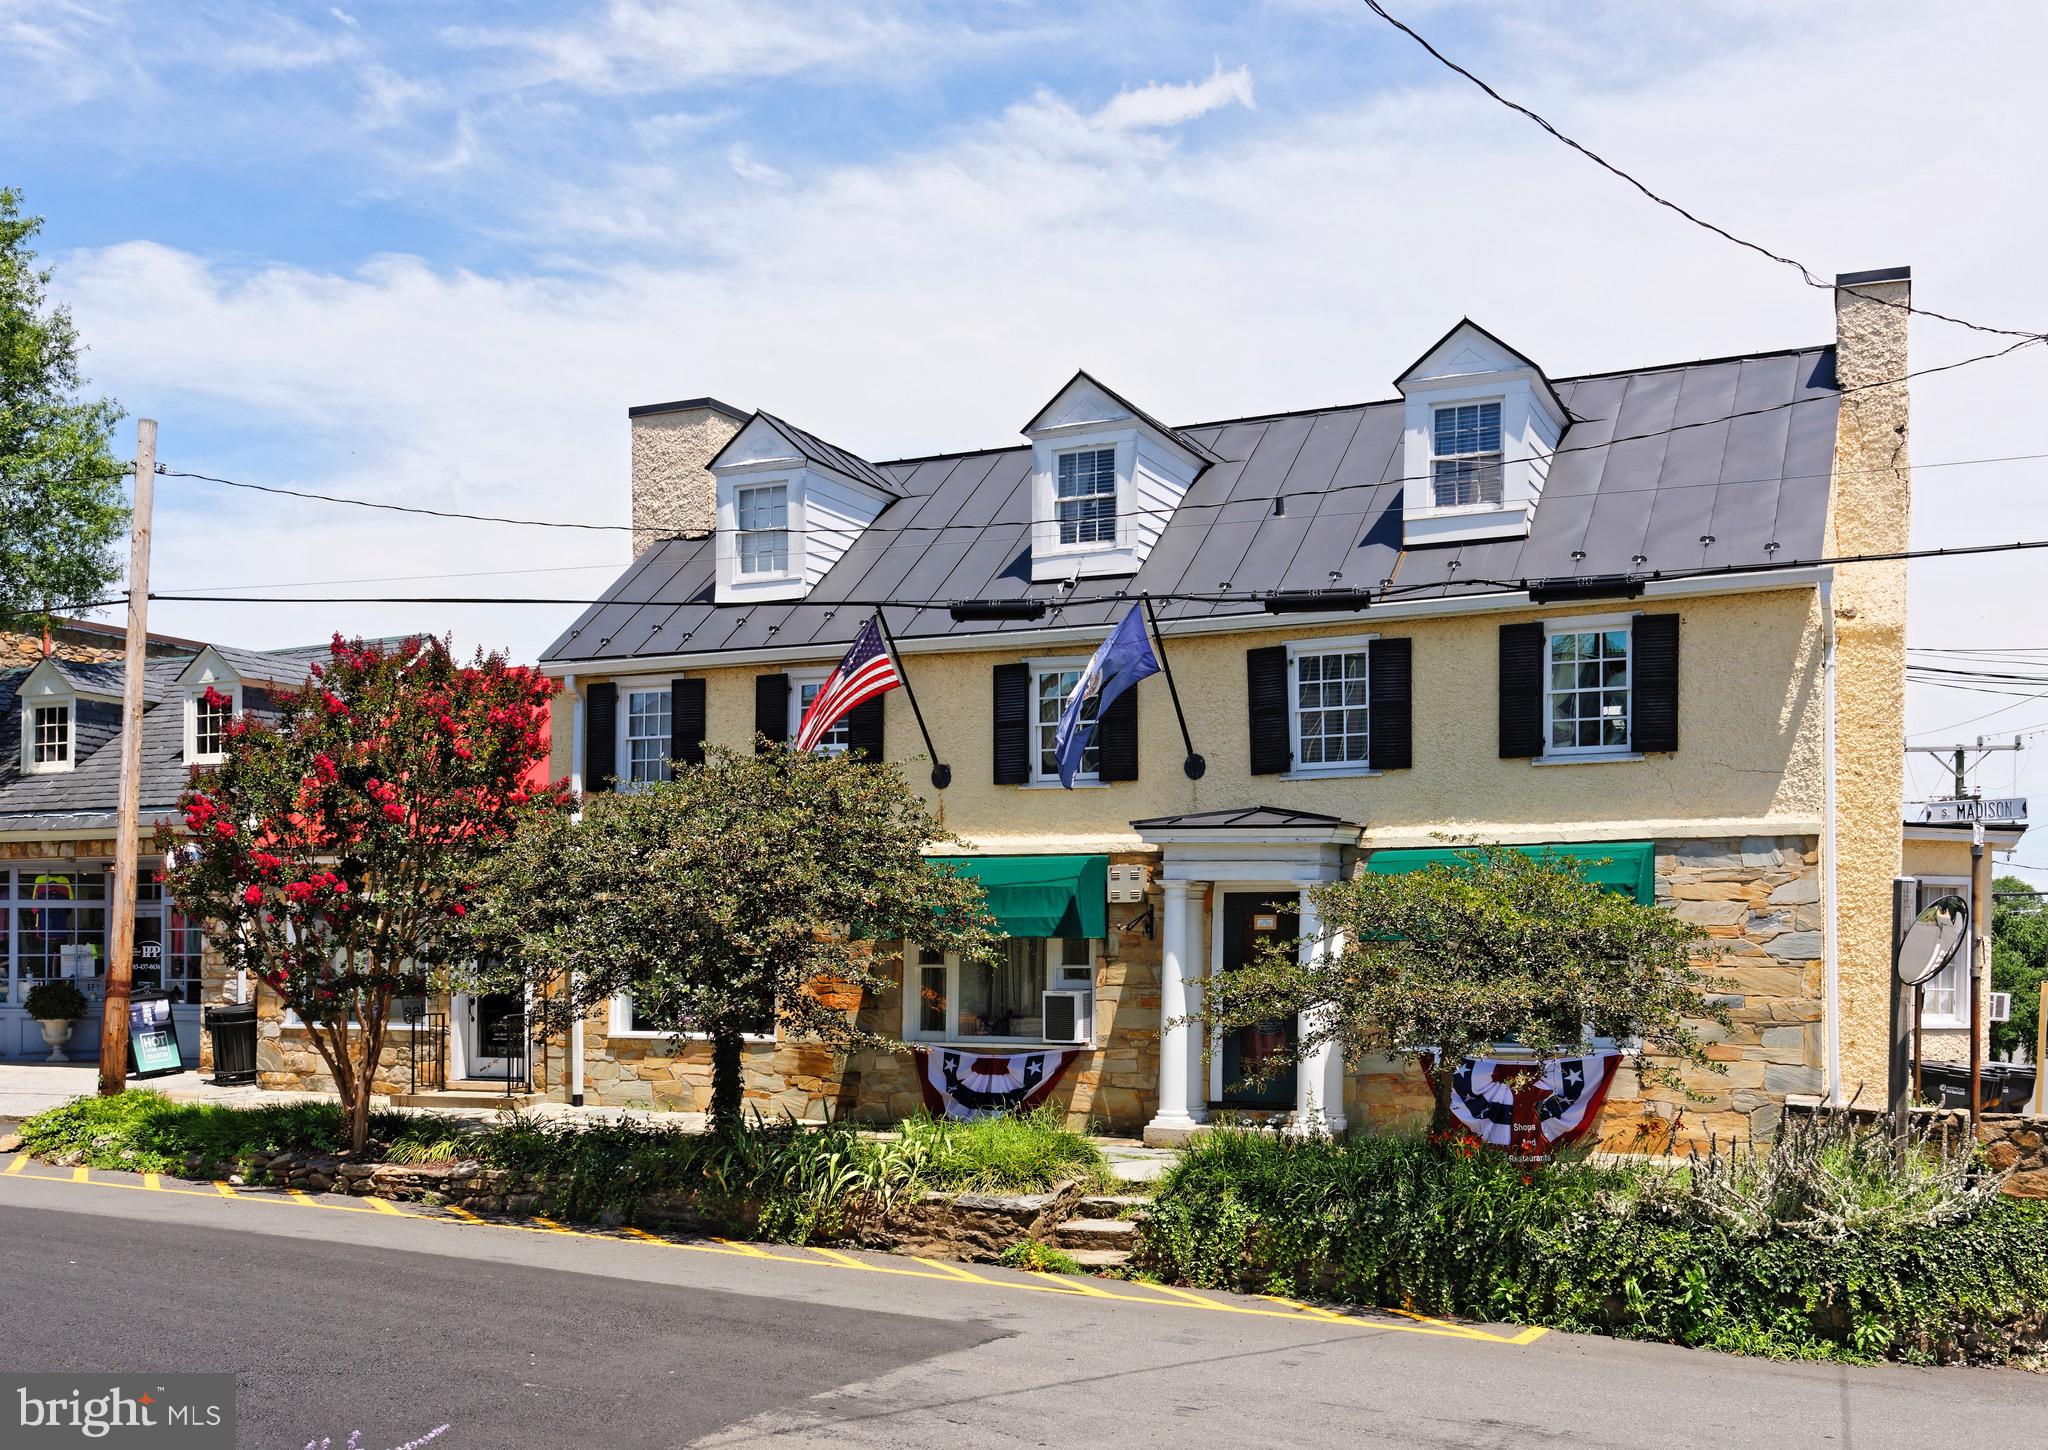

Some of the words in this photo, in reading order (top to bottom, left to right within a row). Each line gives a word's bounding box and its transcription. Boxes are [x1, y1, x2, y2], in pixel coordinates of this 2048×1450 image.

[1941, 808, 1950, 817] S.
[1957, 801, 2012, 820] MADISON
[143, 1035, 165, 1048] HOT
[1513, 1123, 1536, 1132] Shops
[1508, 1154, 1552, 1162] Restaurants
